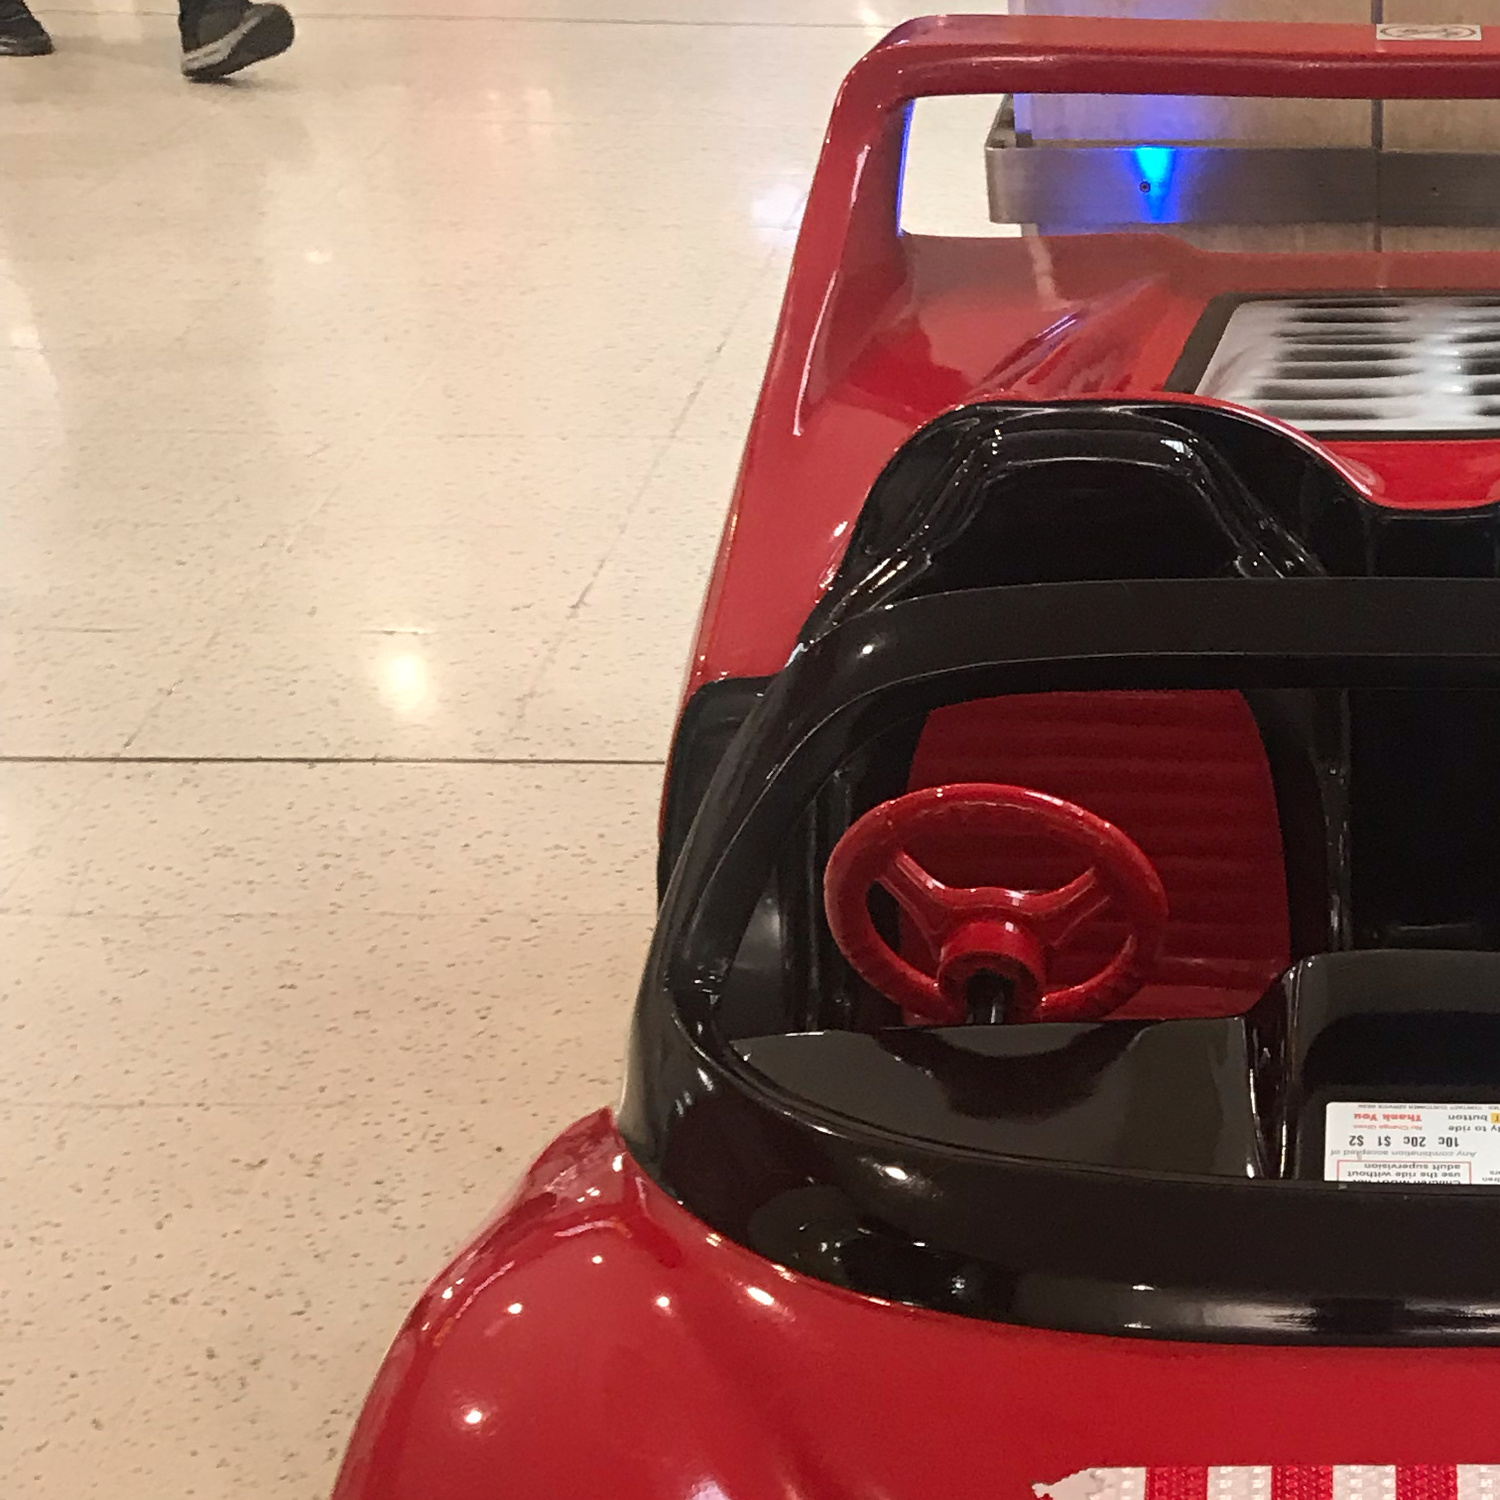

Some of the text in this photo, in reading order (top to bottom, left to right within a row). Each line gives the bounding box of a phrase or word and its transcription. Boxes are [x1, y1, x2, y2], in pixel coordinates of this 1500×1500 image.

[1354, 1113, 1422, 1122] Thank You
[1348, 1135, 1459, 1147] 10c 20c $1 $2
